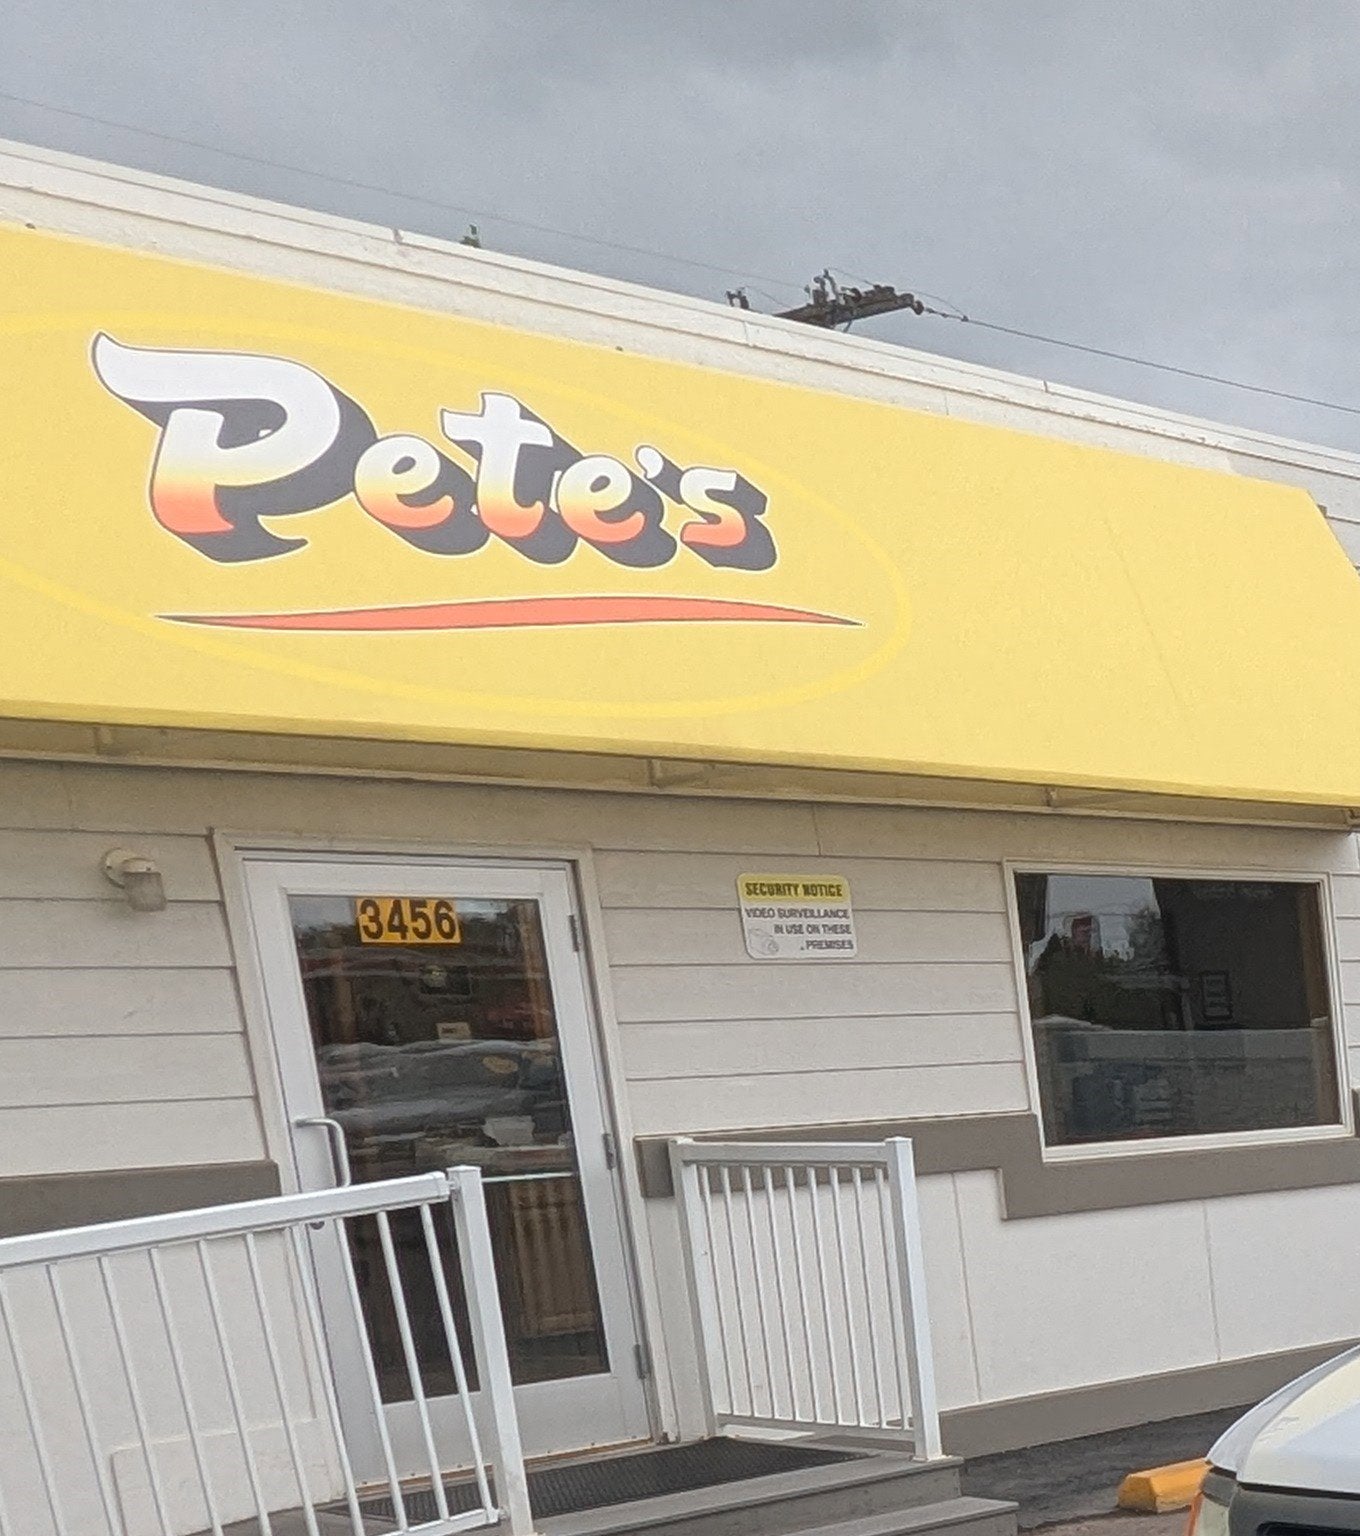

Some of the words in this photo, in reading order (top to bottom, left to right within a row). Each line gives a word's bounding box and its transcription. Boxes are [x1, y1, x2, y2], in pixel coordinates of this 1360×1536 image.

[92, 331, 778, 571] Pete's
[745, 882, 800, 897] SECURITY
[801, 883, 843, 897] NOTICE
[744, 907, 775, 918] VIDEO
[777, 907, 850, 919] SURVEILLANCE
[360, 899, 456, 941] 3456
[774, 923, 784, 934] IN
[785, 923, 804, 935] USE
[806, 923, 820, 934] ON
[821, 923, 852, 935] THESE
[805, 939, 854, 950] PREMISES
